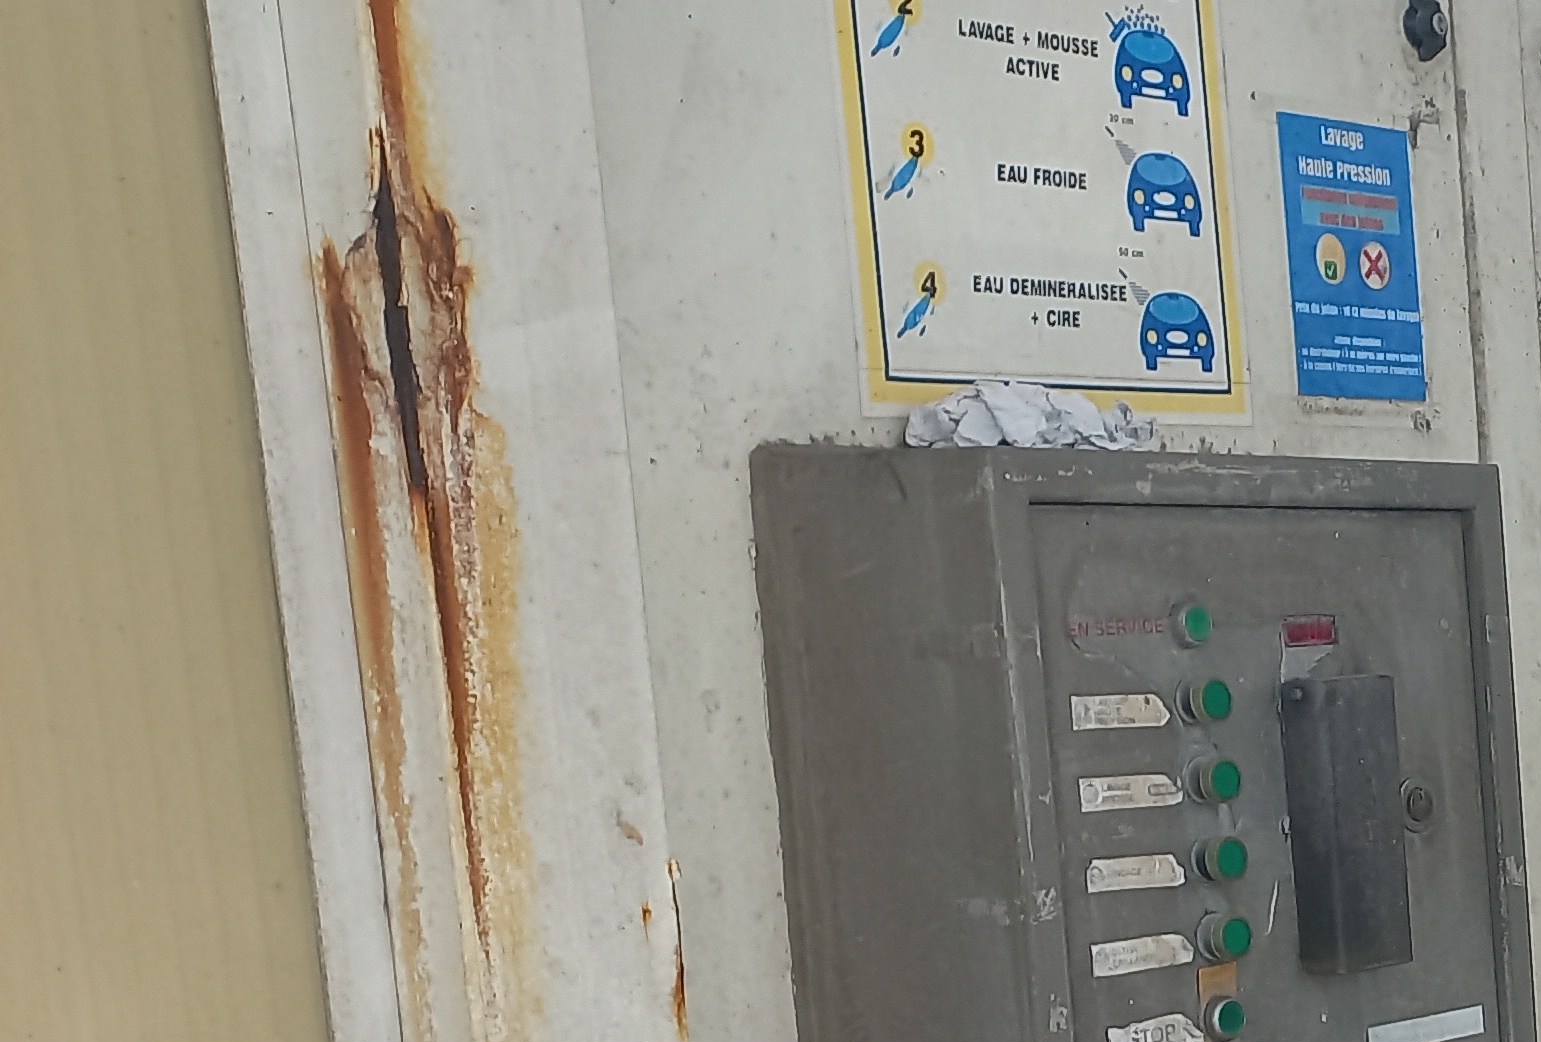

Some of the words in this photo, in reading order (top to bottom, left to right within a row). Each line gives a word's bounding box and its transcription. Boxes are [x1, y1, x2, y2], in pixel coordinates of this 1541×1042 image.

[957, 19, 1015, 45] LAVAGE
[1037, 31, 1099, 58] MOUSSE
[1006, 57, 1060, 82] ACTIVE
[908, 129, 925, 158] 3
[1320, 125, 1364, 151] Lavage
[997, 163, 1028, 184] EAU
[1033, 167, 1087, 190] FROIDE
[1298, 155, 1334, 179] Haute
[1336, 161, 1391, 186] Pression
[921, 271, 937, 299] 4
[972, 274, 1004, 294] EAU
[1010, 276, 1128, 303] DEMINERALISEE
[1046, 309, 1081, 329] CIRE
[1096, 617, 1164, 636] SERVICE
